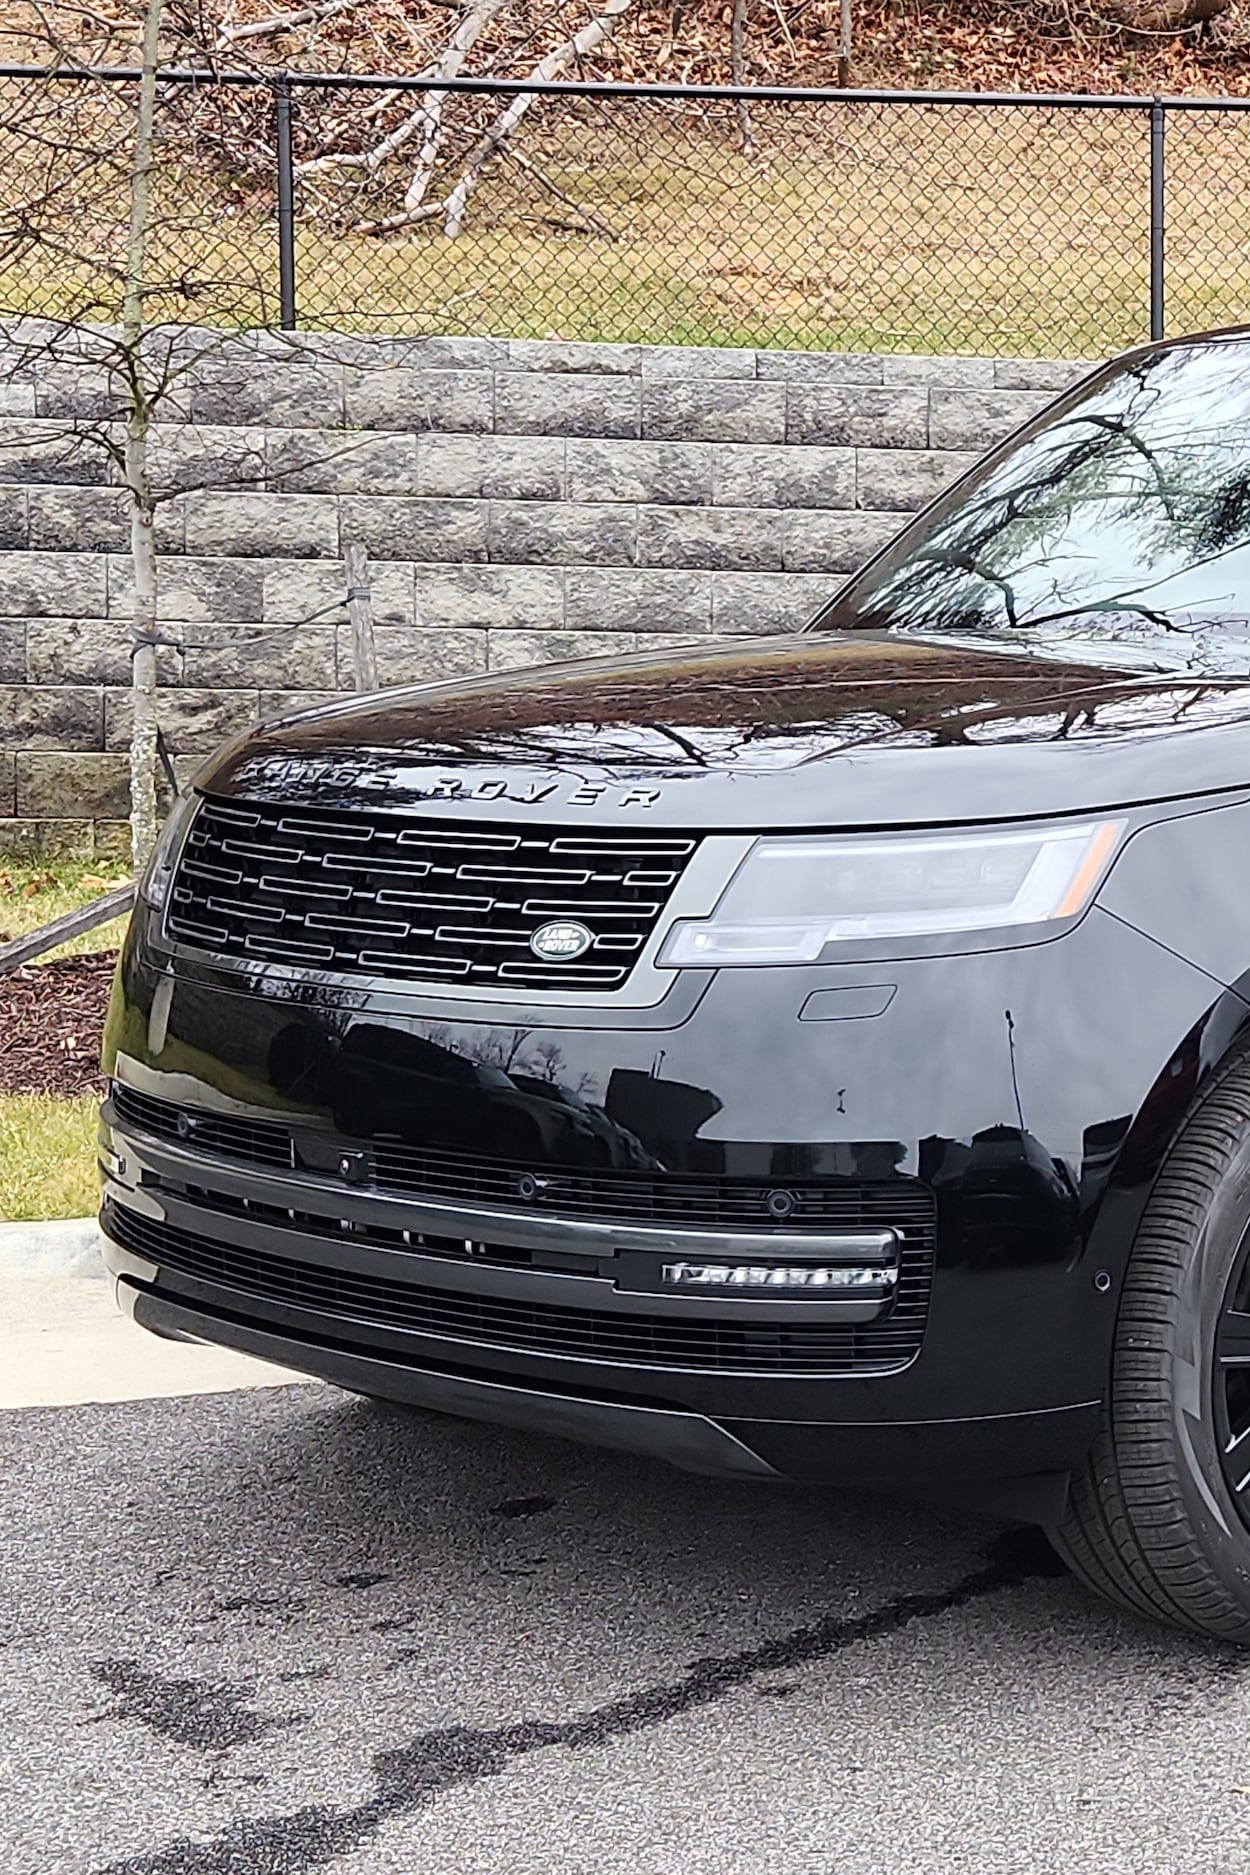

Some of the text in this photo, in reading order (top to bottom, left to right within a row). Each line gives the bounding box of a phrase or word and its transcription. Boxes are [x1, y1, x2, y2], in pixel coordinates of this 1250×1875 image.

[240, 757, 663, 809] RANGE ROVER
[542, 929, 573, 940] LAND
[542, 940, 580, 951] ROVER
